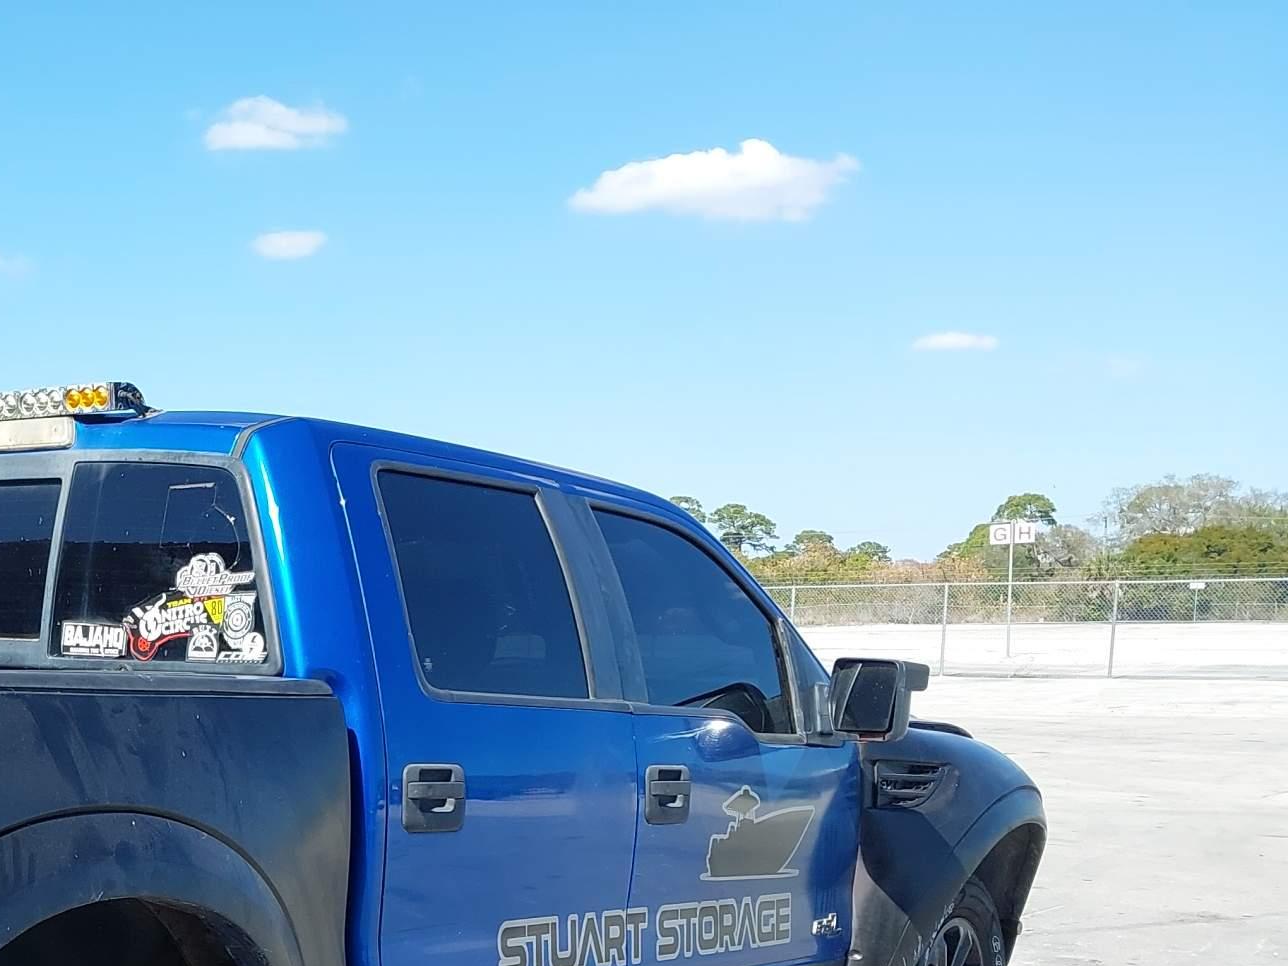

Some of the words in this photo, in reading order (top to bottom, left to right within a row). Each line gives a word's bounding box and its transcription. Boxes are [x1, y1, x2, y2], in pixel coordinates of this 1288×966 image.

[993, 527, 1007, 541] G
[1018, 526, 1031, 540] H
[161, 601, 204, 624] NITRO
[656, 893, 792, 962] STORAGE
